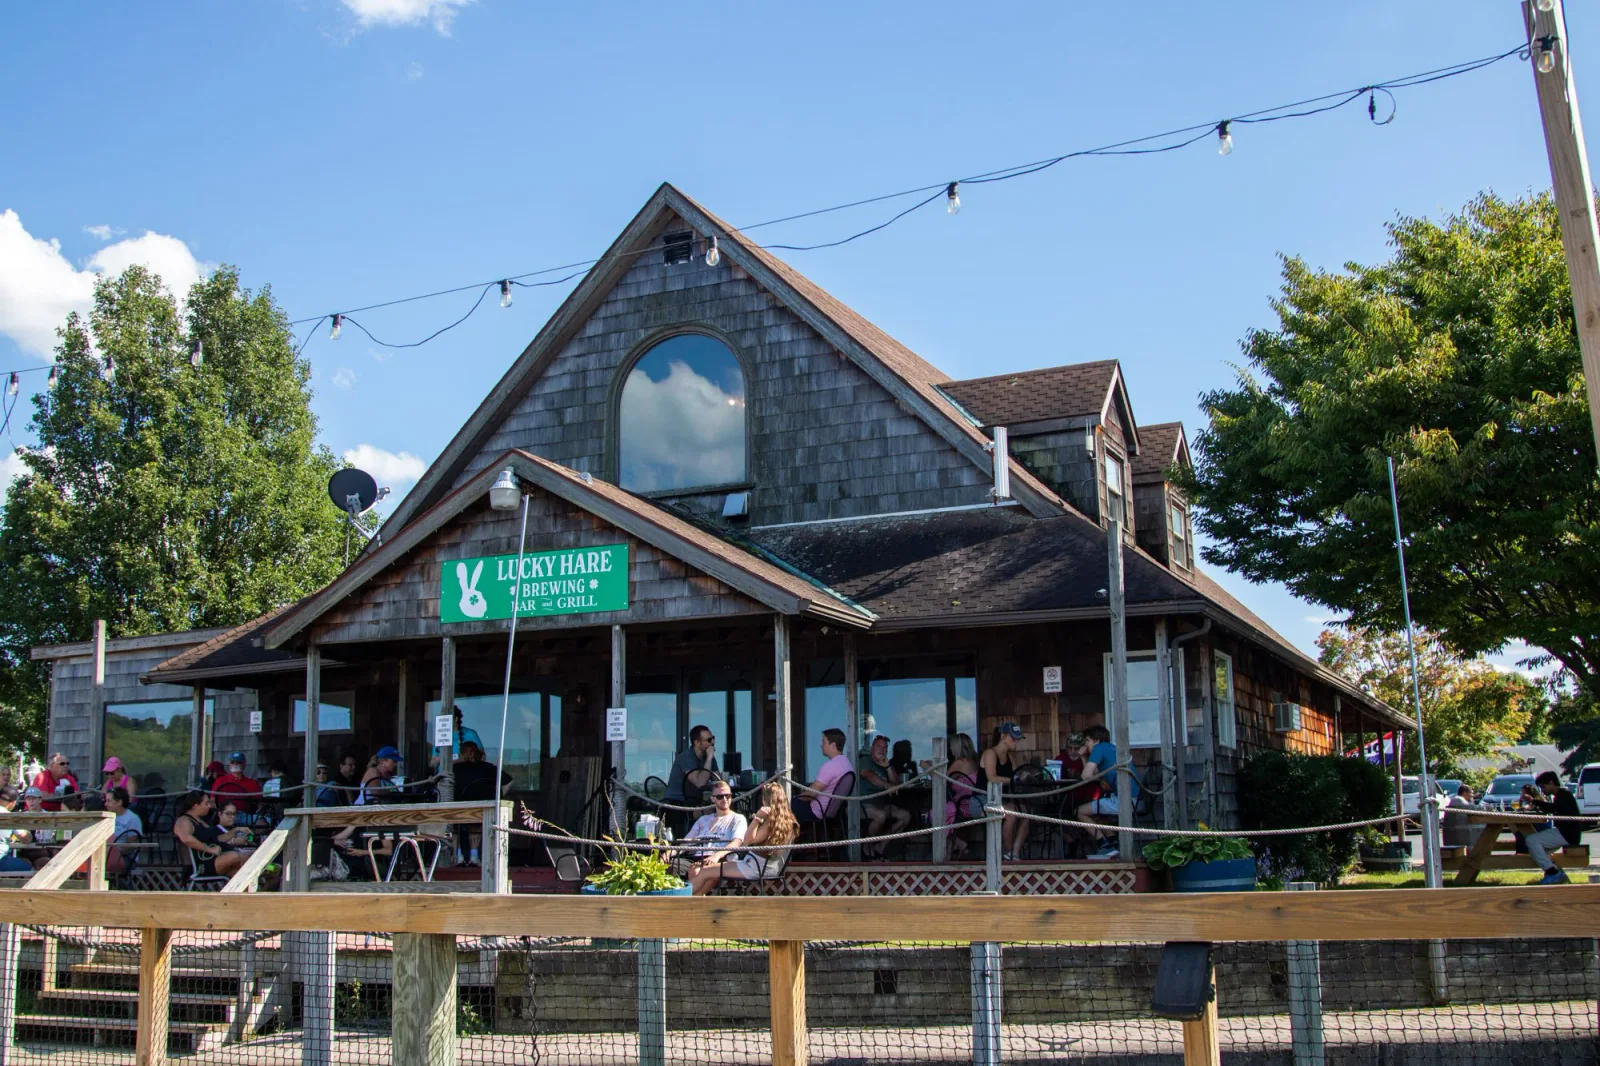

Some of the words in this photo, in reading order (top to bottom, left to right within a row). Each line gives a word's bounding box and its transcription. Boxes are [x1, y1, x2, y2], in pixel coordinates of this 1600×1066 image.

[497, 556, 556, 580] LUCKY
[560, 550, 612, 576] HARE
[522, 579, 585, 597] BREWING
[511, 599, 536, 612] BAR
[557, 595, 597, 608] GRILL
